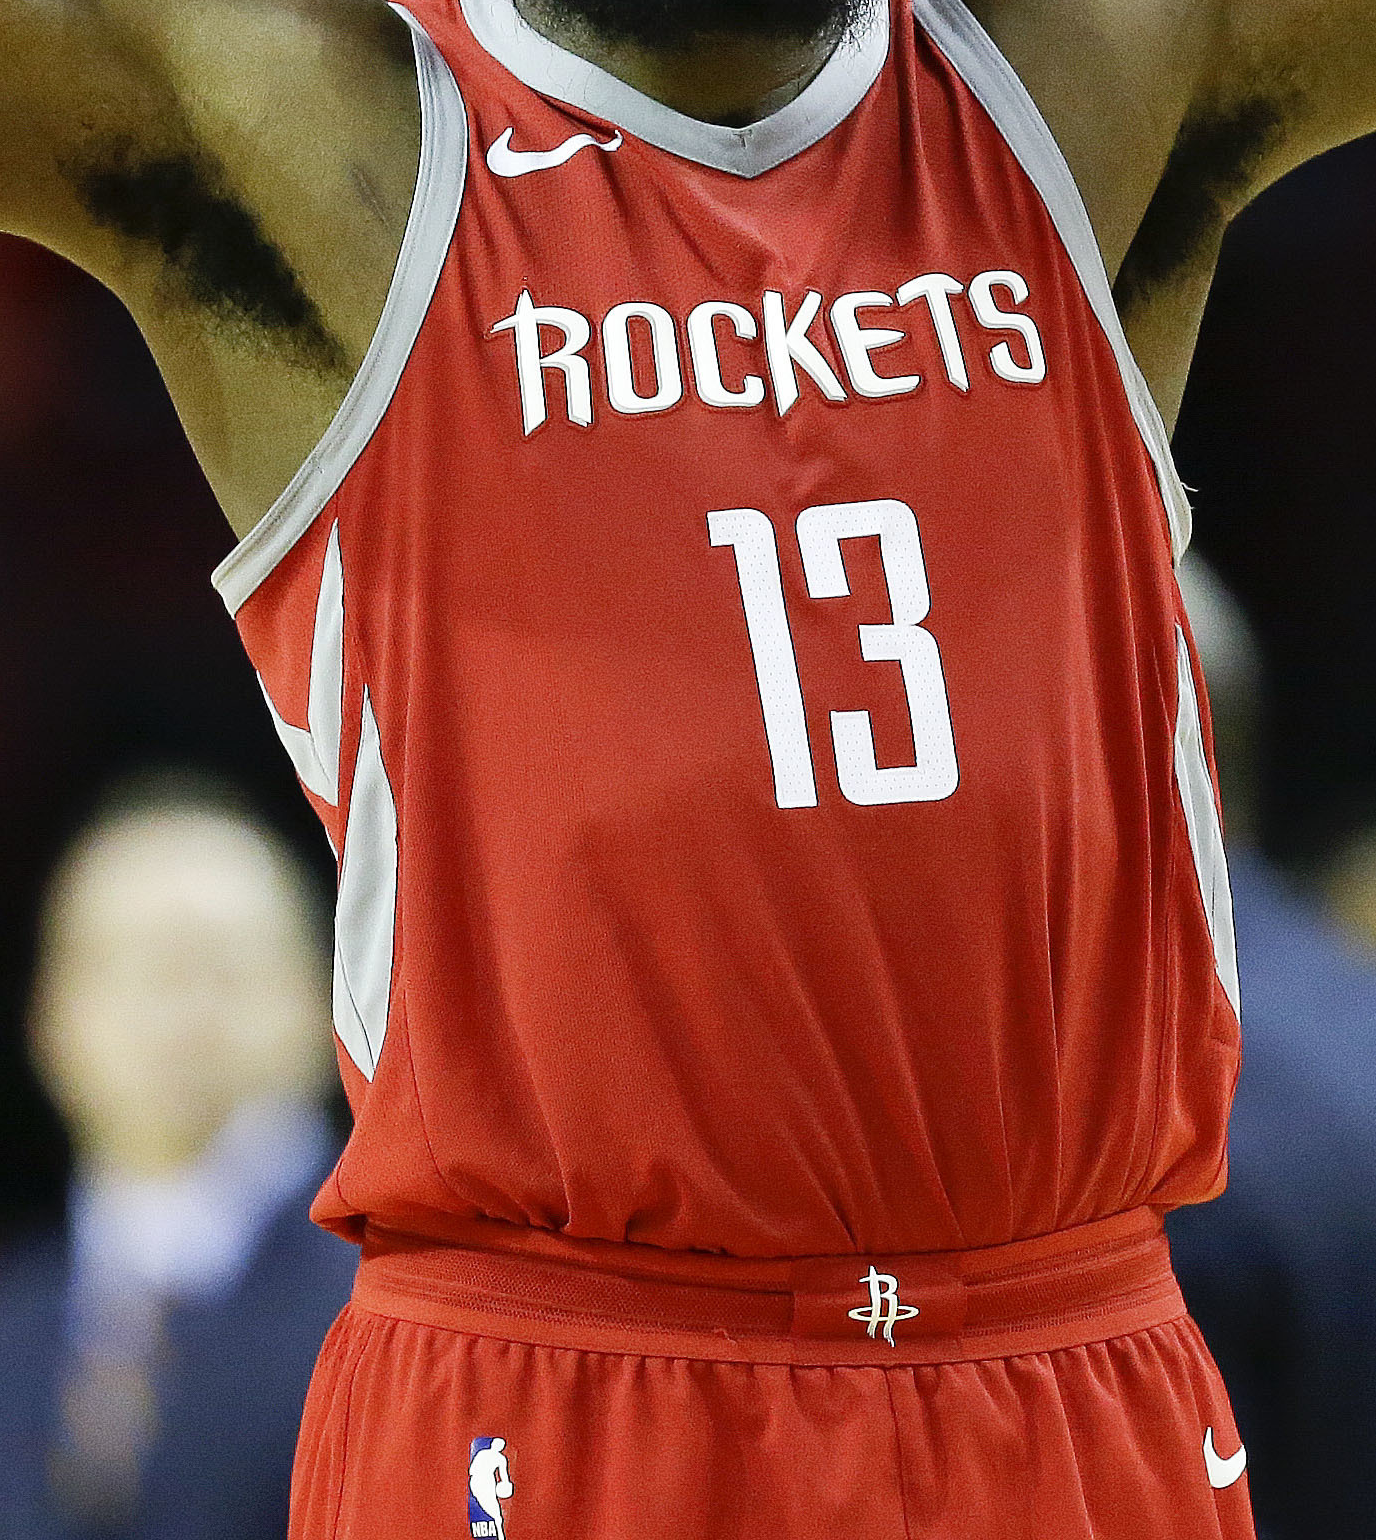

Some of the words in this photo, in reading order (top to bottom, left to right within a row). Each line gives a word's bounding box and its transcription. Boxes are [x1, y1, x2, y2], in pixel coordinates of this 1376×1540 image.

[490, 269, 1047, 437] ROCKETS
[706, 497, 961, 809] 13
[471, 1520, 497, 1538] NBA
